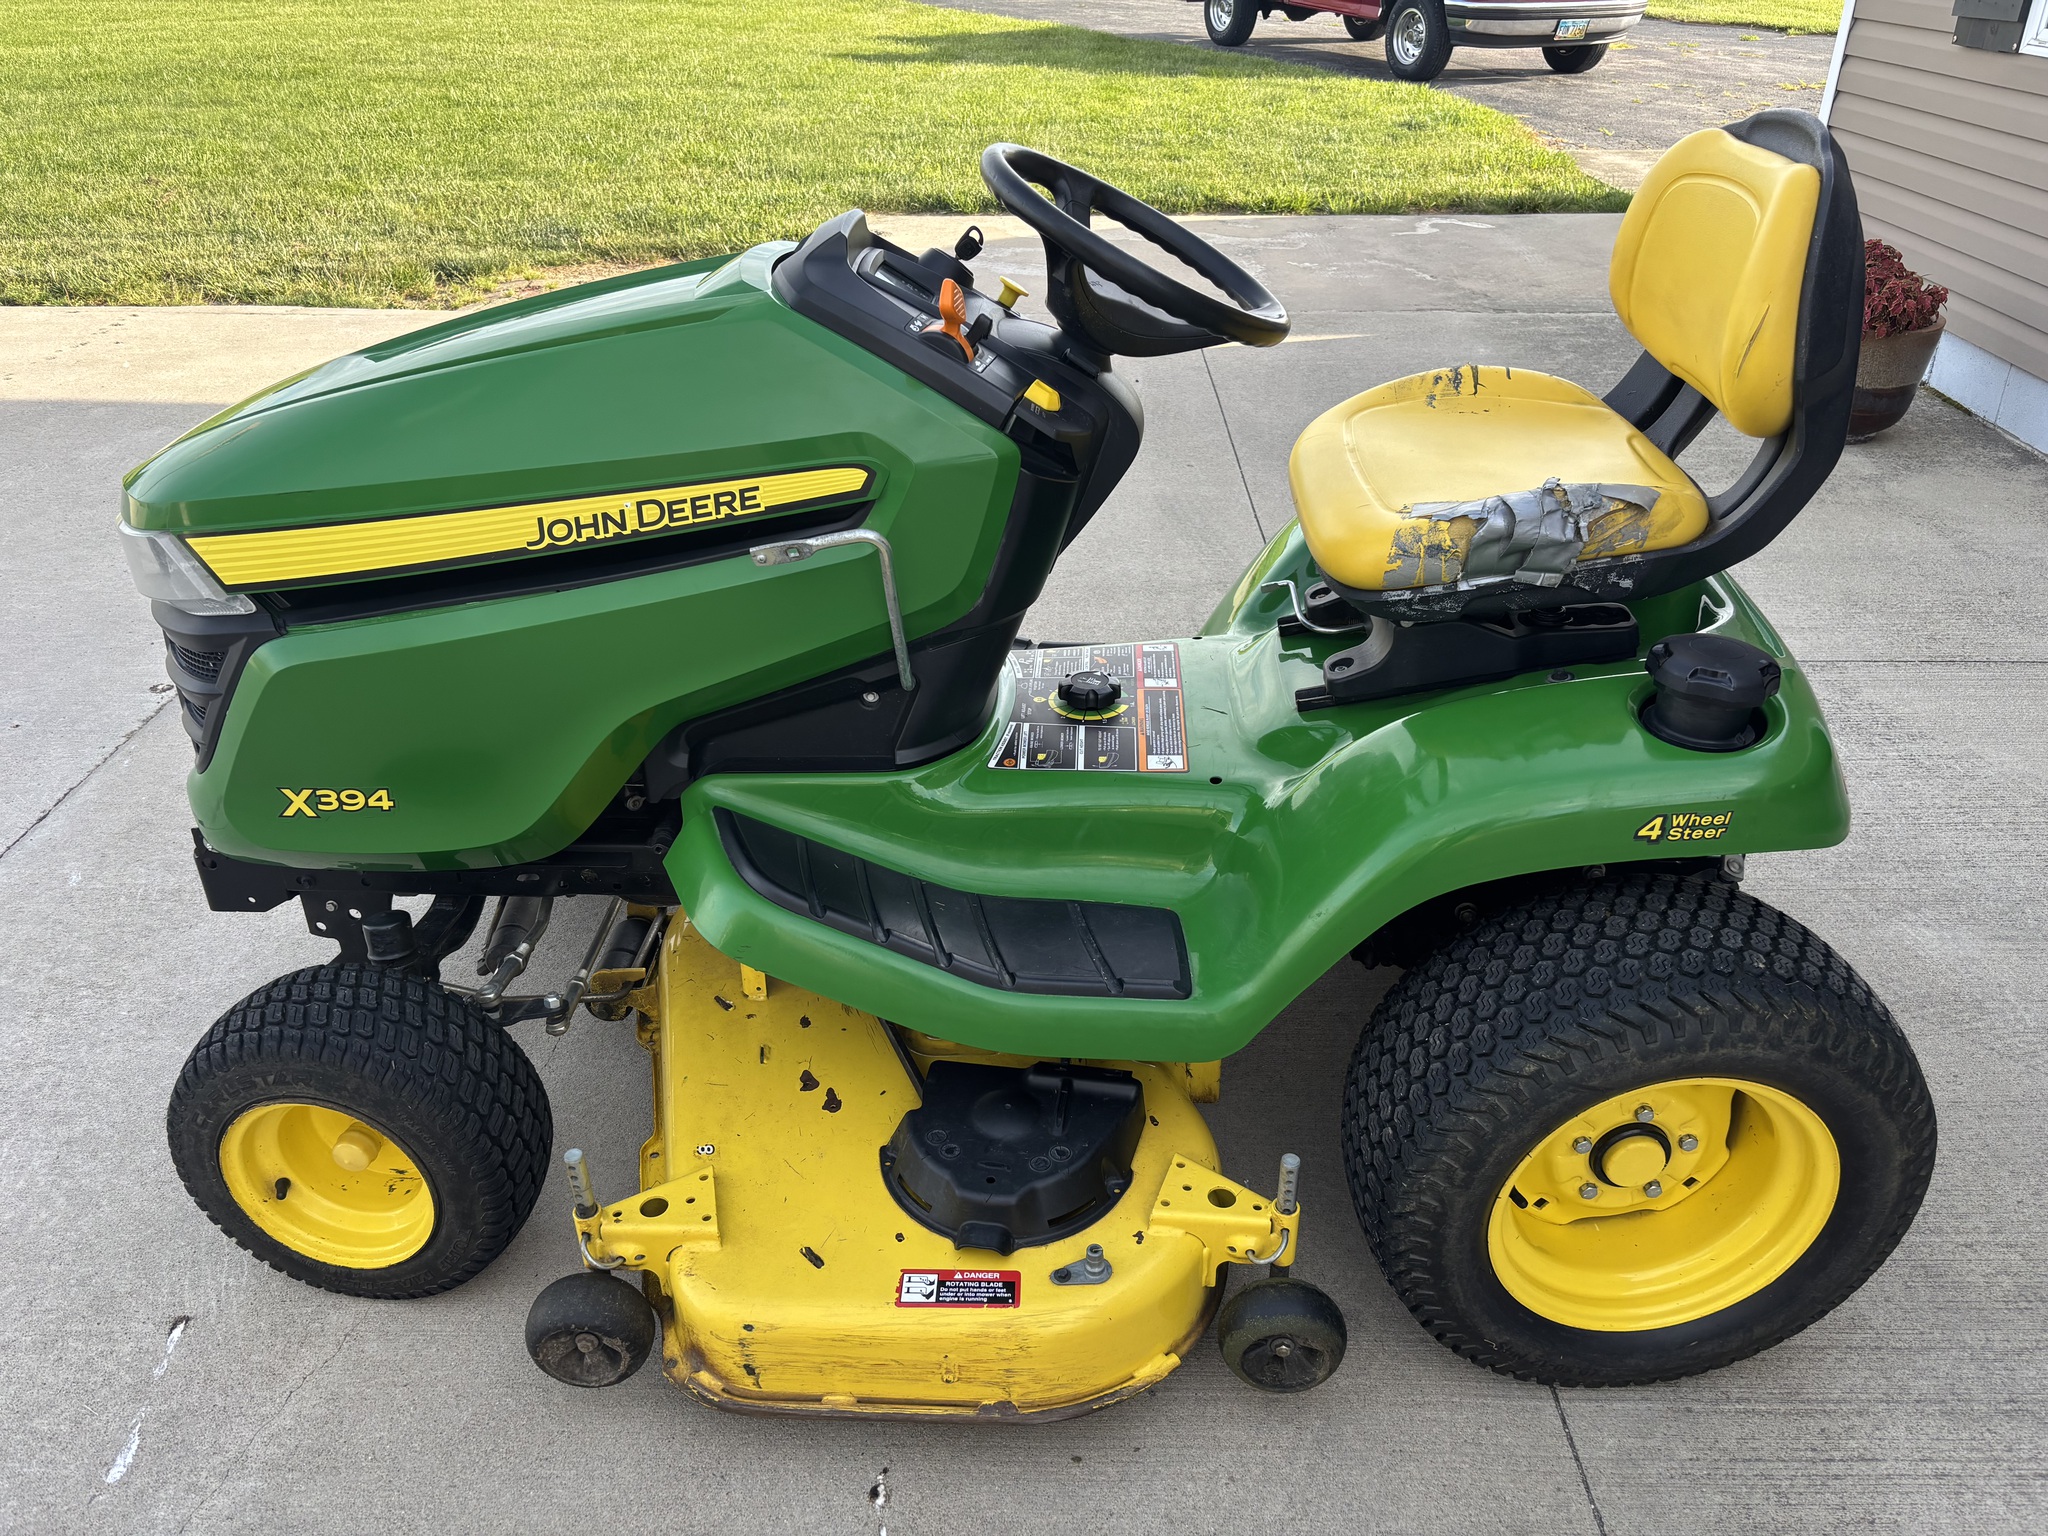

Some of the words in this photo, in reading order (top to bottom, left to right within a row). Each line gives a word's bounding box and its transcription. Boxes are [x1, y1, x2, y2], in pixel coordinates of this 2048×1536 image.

[526, 508, 627, 547] JOHN
[636, 485, 762, 528] DEERE
[278, 788, 395, 817] X394
[1636, 815, 1665, 841] 4
[1672, 811, 1733, 827] Wheel
[1667, 827, 1727, 841] Steer
